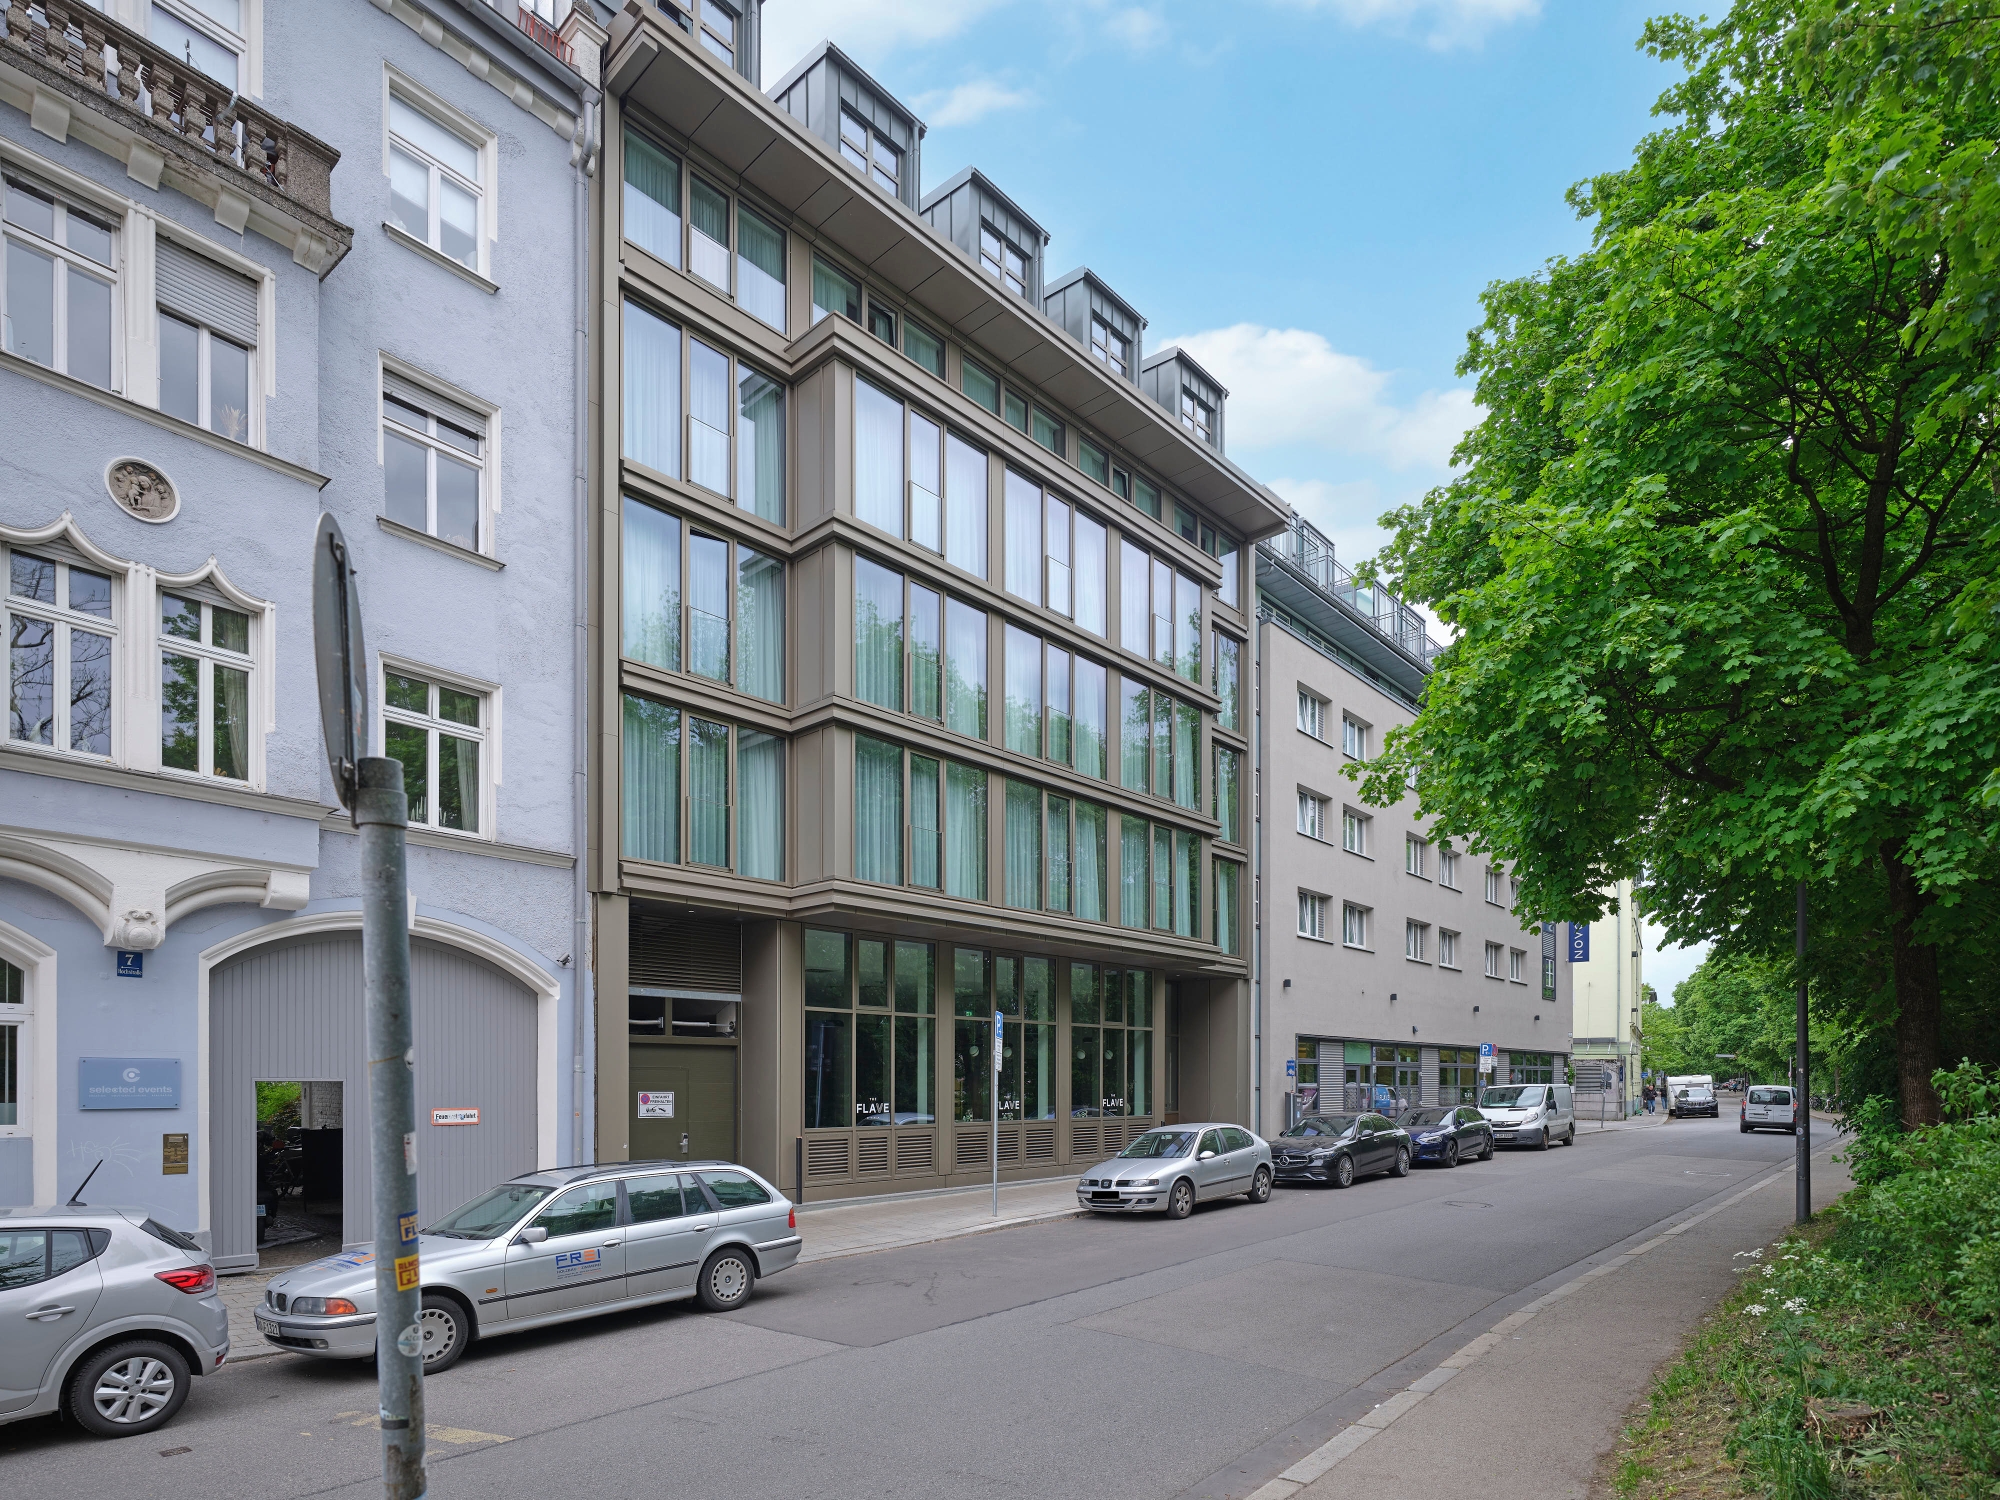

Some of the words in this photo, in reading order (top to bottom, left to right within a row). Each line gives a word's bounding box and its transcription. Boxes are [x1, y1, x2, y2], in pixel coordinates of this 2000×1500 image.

[125, 954, 134, 966] 7
[1481, 1045, 1489, 1055] P
[89, 1085, 136, 1094] selected
[138, 1086, 173, 1094] events
[998, 1100, 1020, 1110] LAVE
[1102, 1098, 1124, 1107] FLAVE
[856, 1103, 889, 1113] FLAVE
[555, 1249, 602, 1266] FREI
